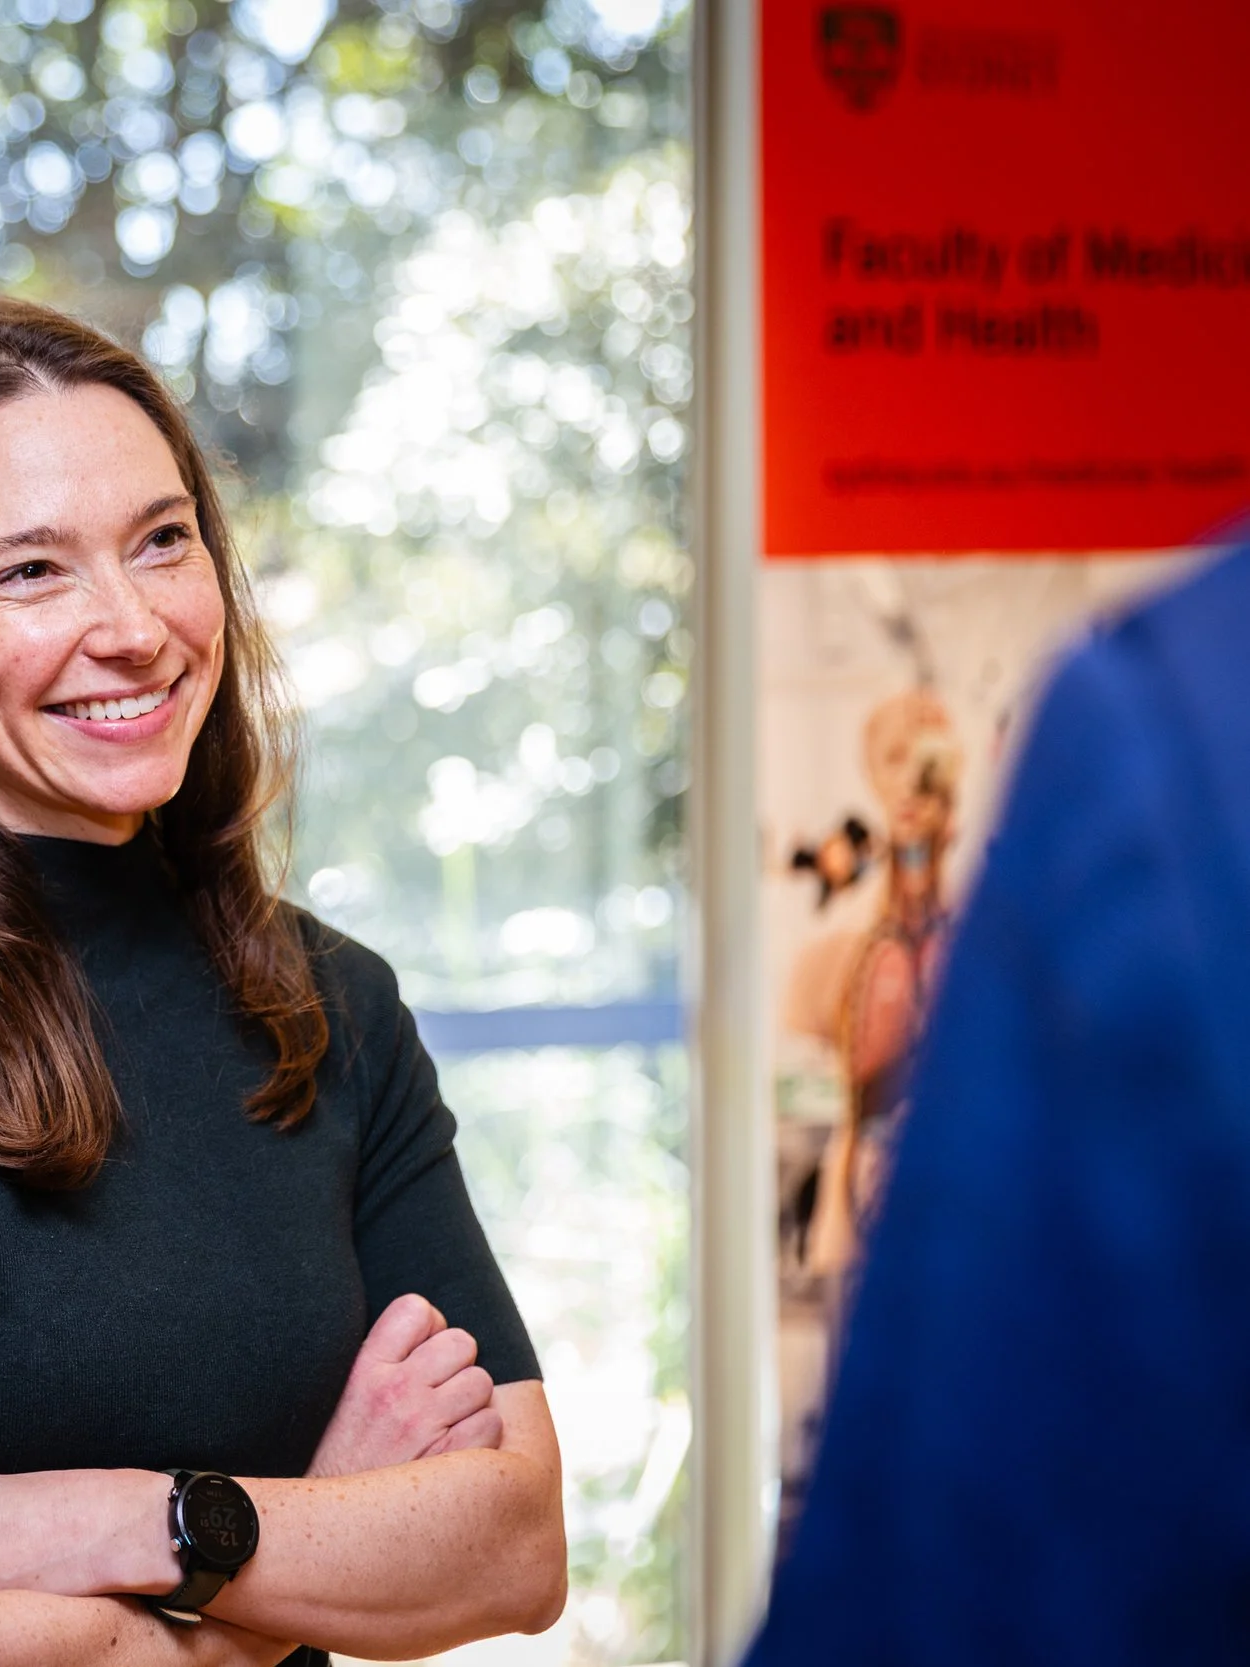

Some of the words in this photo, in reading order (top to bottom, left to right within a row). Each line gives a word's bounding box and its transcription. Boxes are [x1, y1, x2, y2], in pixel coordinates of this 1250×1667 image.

[1021, 226, 1072, 283] of
[209, 1506, 237, 1530] 29
[219, 1530, 238, 1547] 12
